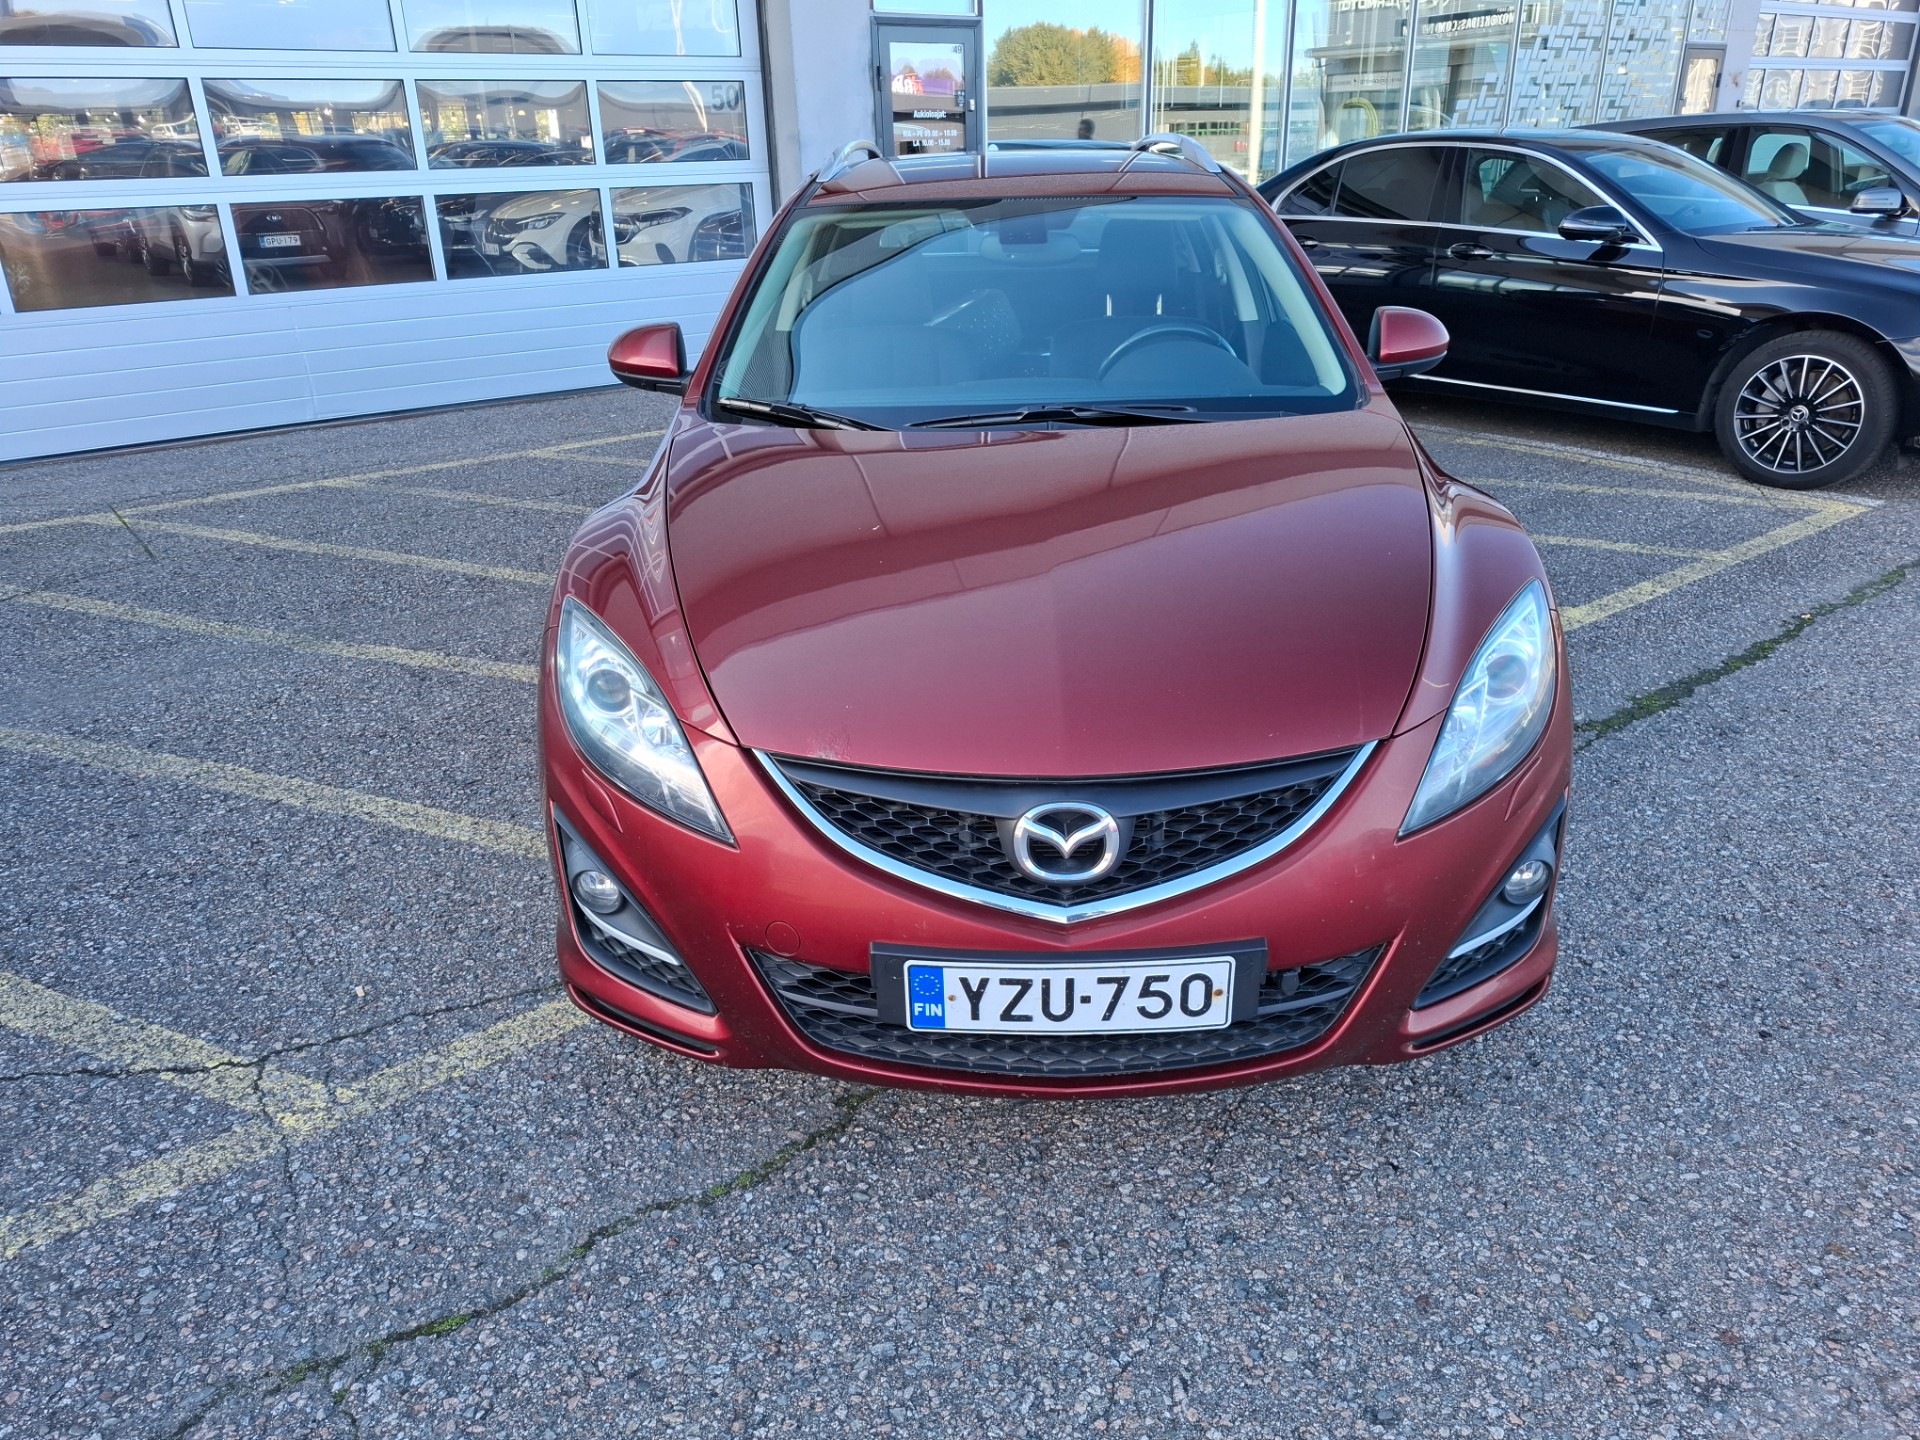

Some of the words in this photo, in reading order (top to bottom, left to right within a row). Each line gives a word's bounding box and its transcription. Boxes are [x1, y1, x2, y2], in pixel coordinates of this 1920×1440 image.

[952, 46, 962, 54] 49
[711, 85, 739, 111] 50
[266, 236, 298, 246] GPU-179
[914, 1003, 943, 1017] FIN
[958, 973, 1213, 1023] YZU-750
